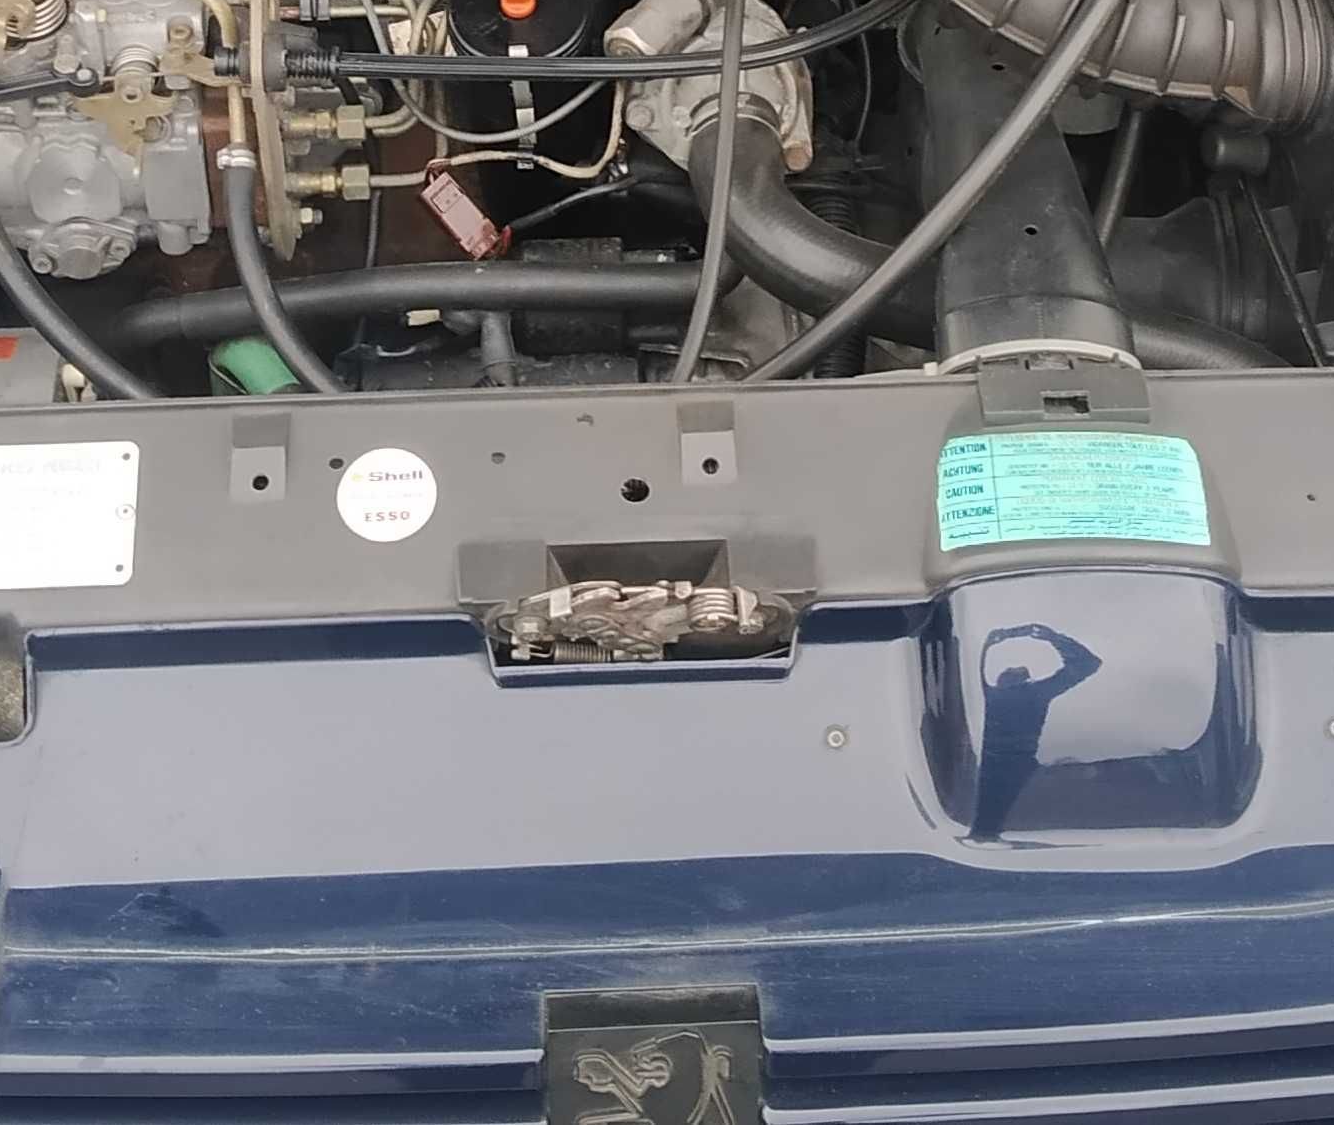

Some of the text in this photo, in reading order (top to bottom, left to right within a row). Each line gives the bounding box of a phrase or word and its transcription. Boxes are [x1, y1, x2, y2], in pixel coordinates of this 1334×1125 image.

[369, 470, 423, 482] Shell
[944, 464, 984, 477] ACHTUNG
[945, 484, 984, 499] CAUTION
[364, 511, 411, 522] ESSO
